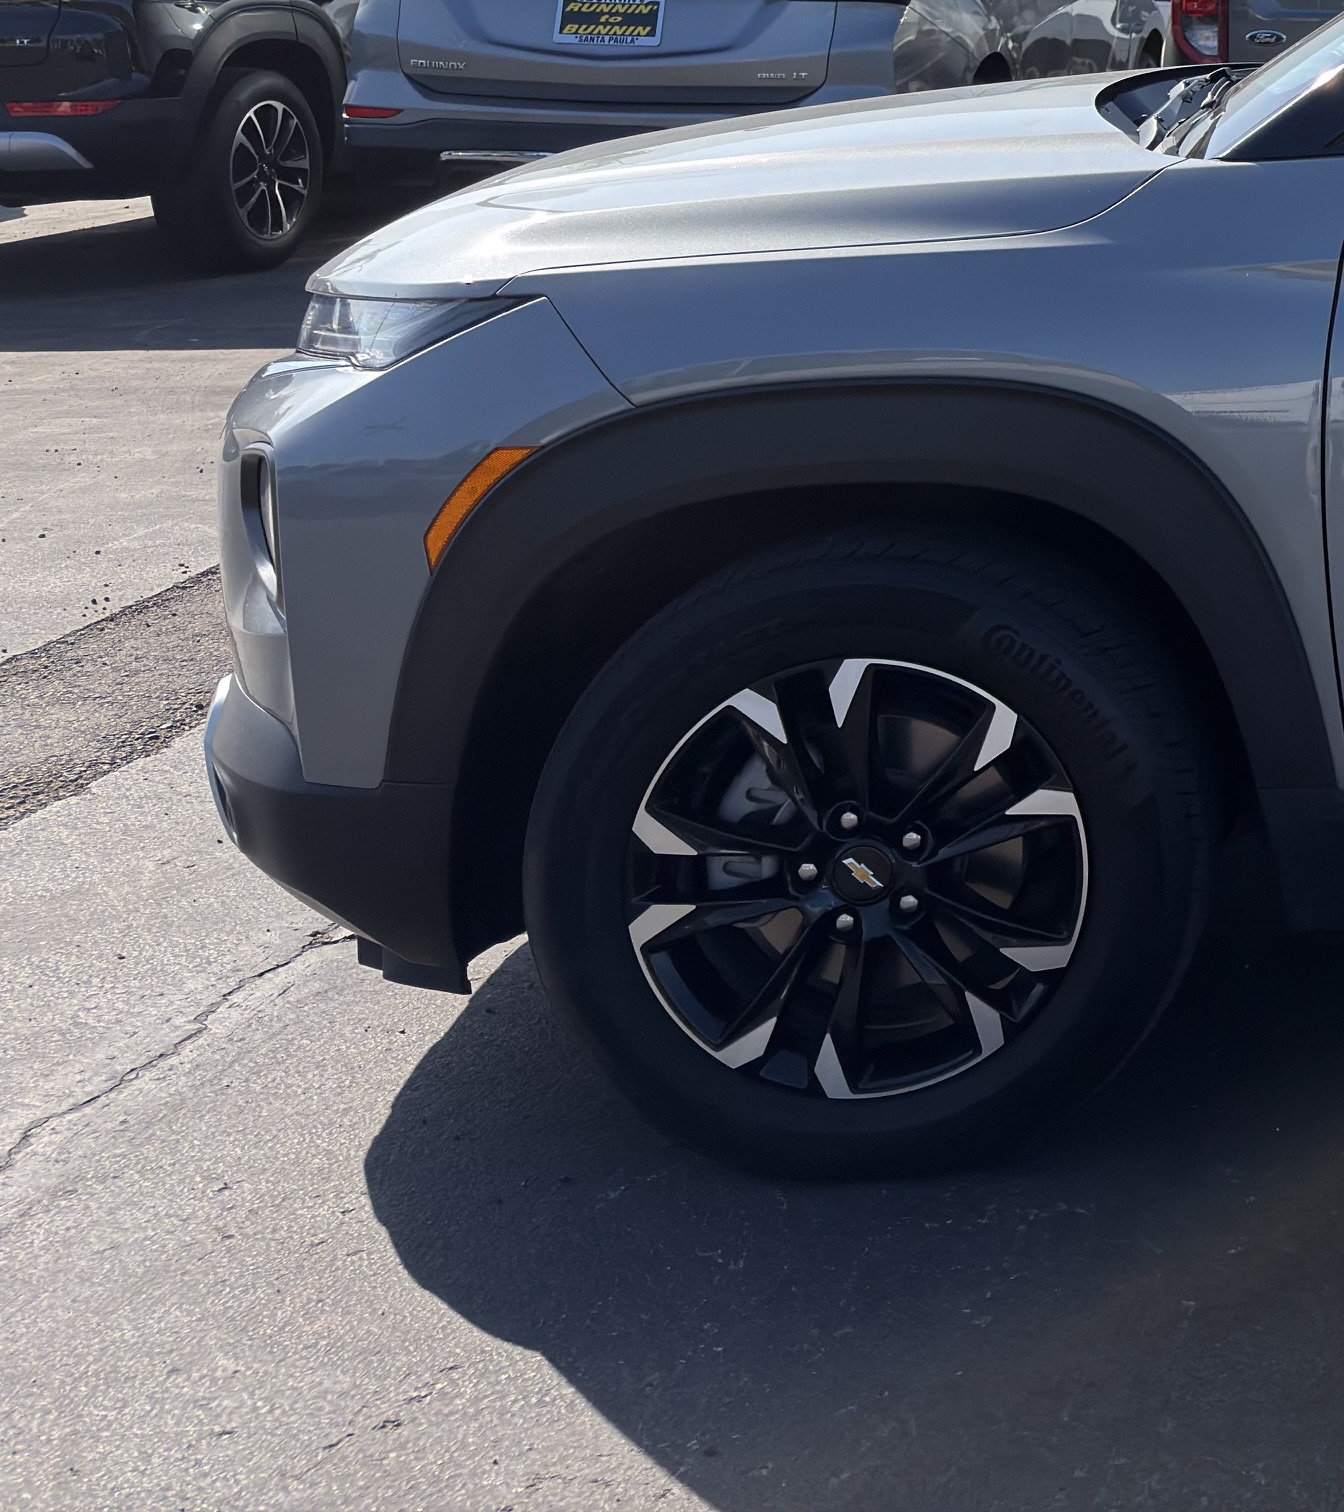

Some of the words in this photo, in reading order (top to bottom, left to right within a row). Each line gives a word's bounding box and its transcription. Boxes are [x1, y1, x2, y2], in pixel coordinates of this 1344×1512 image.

[565, 2, 658, 14] RUNNIN'
[599, 14, 623, 23] to
[562, 24, 652, 36] BUNNIN
[1254, 32, 1277, 43] Ford
